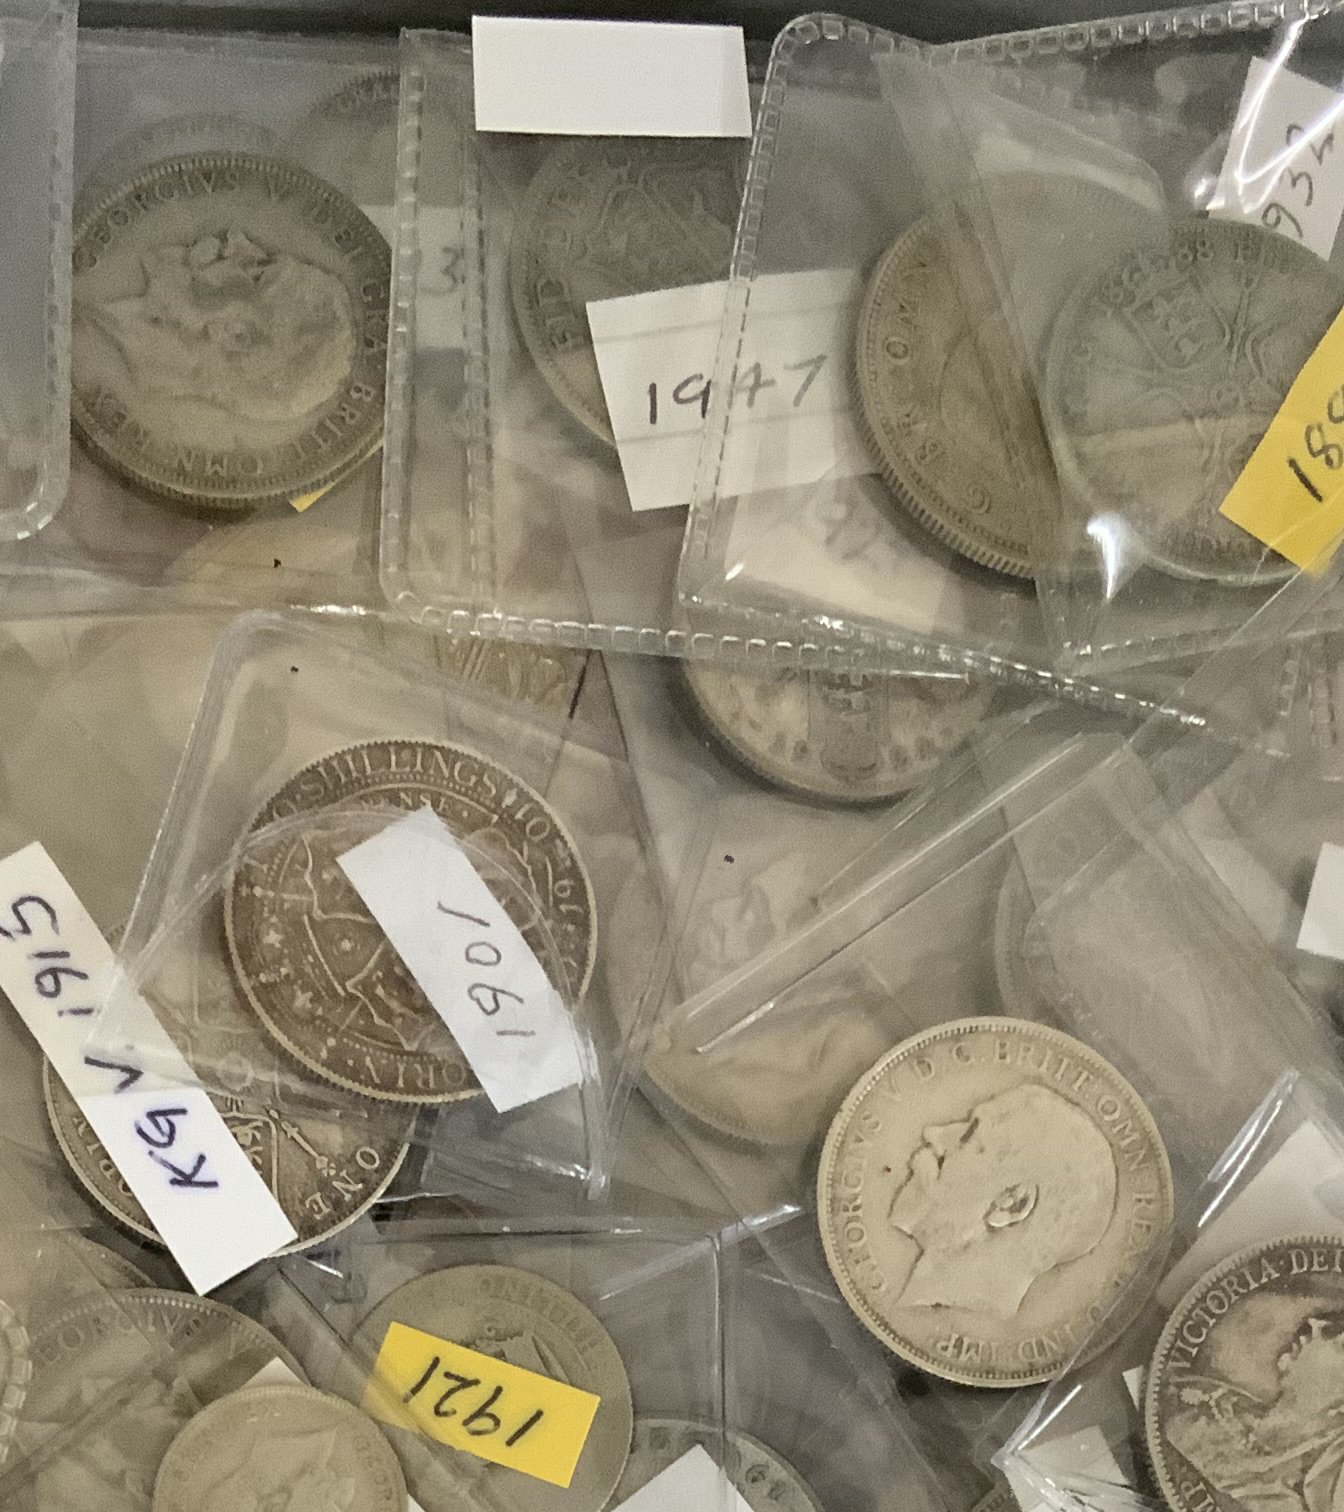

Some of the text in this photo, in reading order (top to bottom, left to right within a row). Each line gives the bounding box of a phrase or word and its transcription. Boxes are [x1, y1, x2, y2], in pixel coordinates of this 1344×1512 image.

[647, 354, 826, 425] 1947
[436, 901, 536, 1037] 1901
[402, 1355, 545, 1448] 1921
